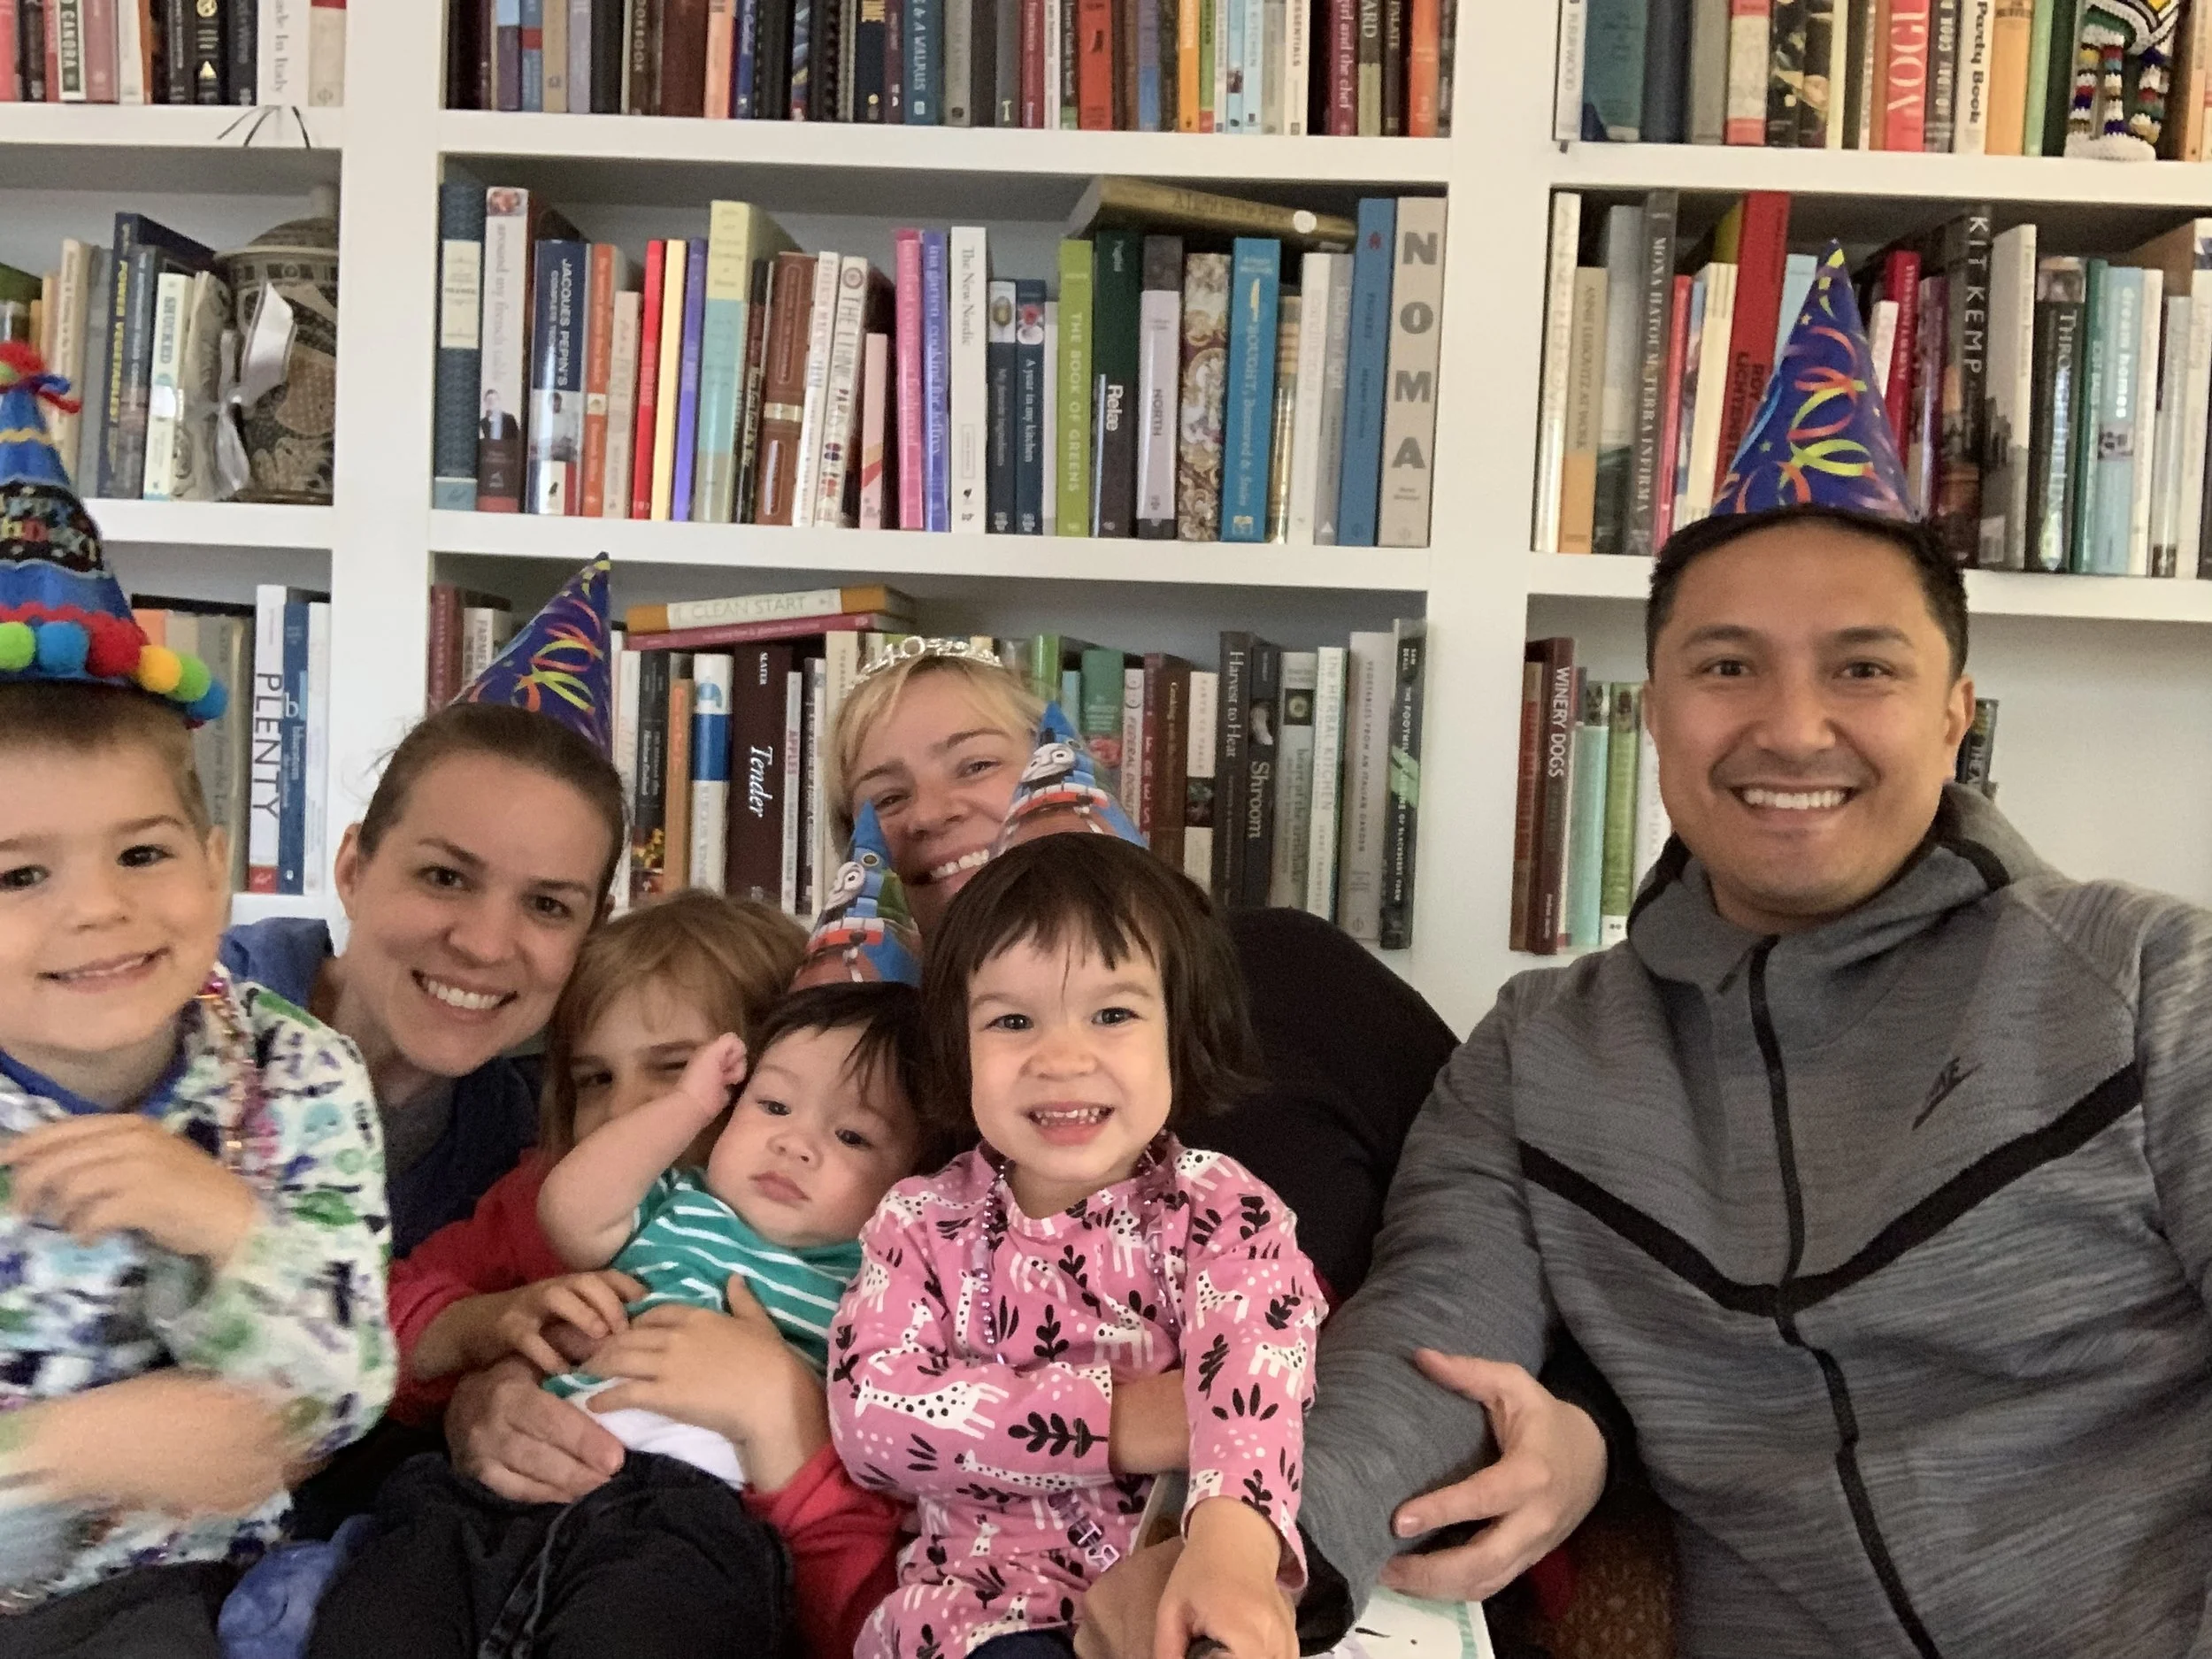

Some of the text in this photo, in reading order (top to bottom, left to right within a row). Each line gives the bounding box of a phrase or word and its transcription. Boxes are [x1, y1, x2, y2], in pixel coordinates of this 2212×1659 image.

[274, 0, 289, 30] ade
[1338, 0, 1355, 20] irl
[1361, 0, 1379, 39] ARD
[1339, 23, 1355, 51] and
[1339, 54, 1355, 77] the
[1969, 1, 1989, 124] Party Book
[841, 295, 862, 328] THE
[960, 246, 976, 347] The New Nordic
[1963, 216, 1989, 373] KIT KEMP
[557, 257, 572, 387] JACQUES PEPIN'S
[1026, 358, 1037, 368] A
[1392, 231, 1440, 471] NOMA
[2115, 288, 2135, 419] dream homes
[1635, 236, 1667, 513] MONA HATOUM TERRA INFIRMA
[1067, 311, 1084, 492] THE BOOK OF GREENS
[1151, 388, 1164, 437] NORTH
[1025, 424, 1037, 464] kitchen
[690, 595, 806, 618] CLEAN START
[758, 651, 769, 686] SLATER
[1228, 650, 1245, 703] Harvest
[1226, 707, 1240, 720] to
[1551, 665, 1571, 729] WINERY
[252, 672, 283, 820] PLENTY
[787, 730, 800, 776] APPLES
[1225, 724, 1241, 757] Heat
[1363, 722, 1371, 751] FROM
[1547, 733, 1566, 779] DOGS
[748, 745, 775, 818] Tender
[1362, 754, 1371, 768] AN
[1125, 772, 1137, 821] DONUT
[1248, 760, 1269, 839] Shroom
